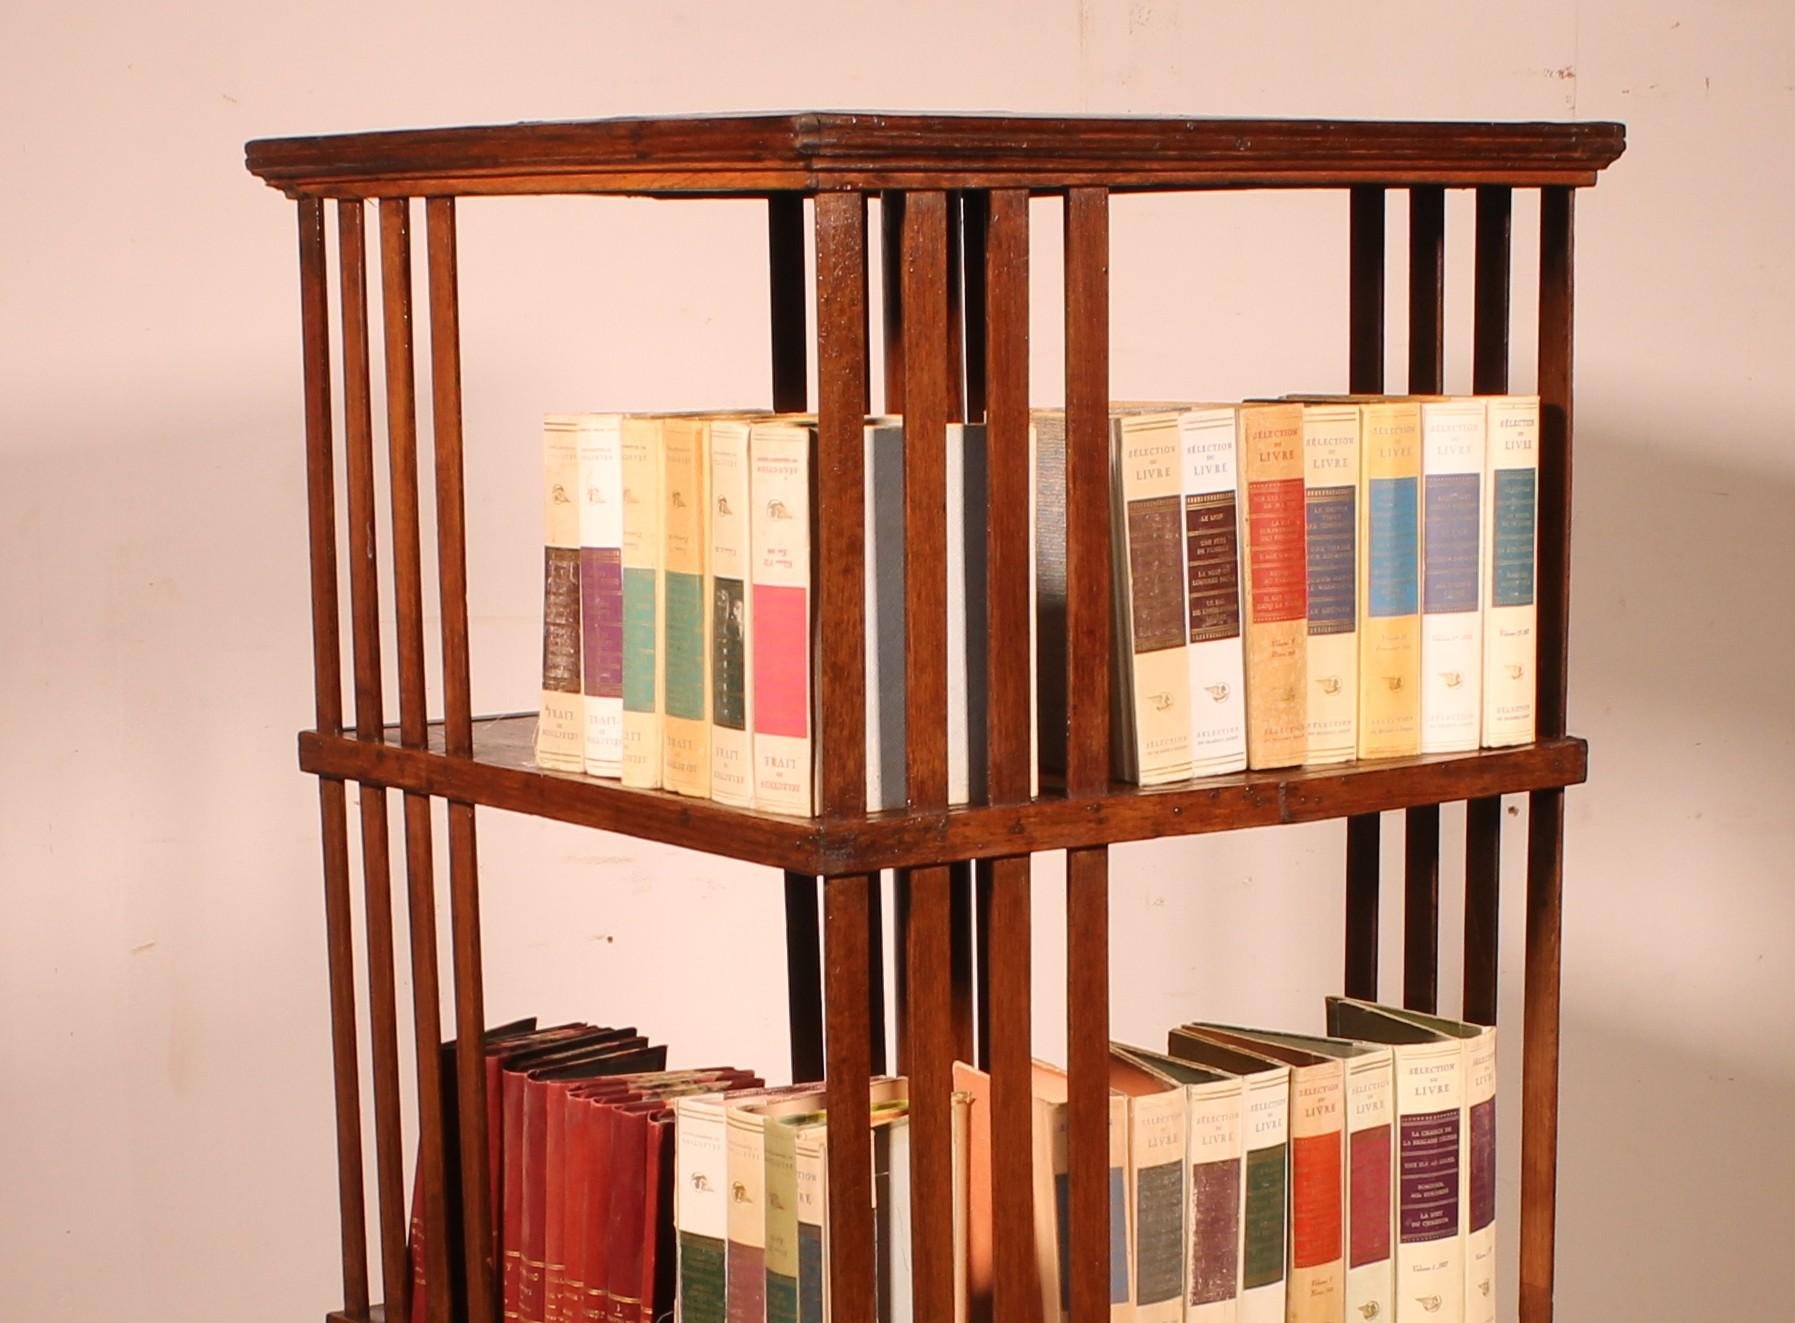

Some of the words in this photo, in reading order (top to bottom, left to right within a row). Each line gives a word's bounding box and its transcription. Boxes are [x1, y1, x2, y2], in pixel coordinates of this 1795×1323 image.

[1259, 449, 1295, 463] LIVRE
[1313, 457, 1349, 469] LIVRE
[1136, 467, 1172, 481] LIVRE
[1194, 463, 1229, 476] LIVRE
[1414, 1083, 1450, 1096] LIVRE
[1305, 1103, 1336, 1118] LIVRE
[1356, 1100, 1384, 1115] LIVRE
